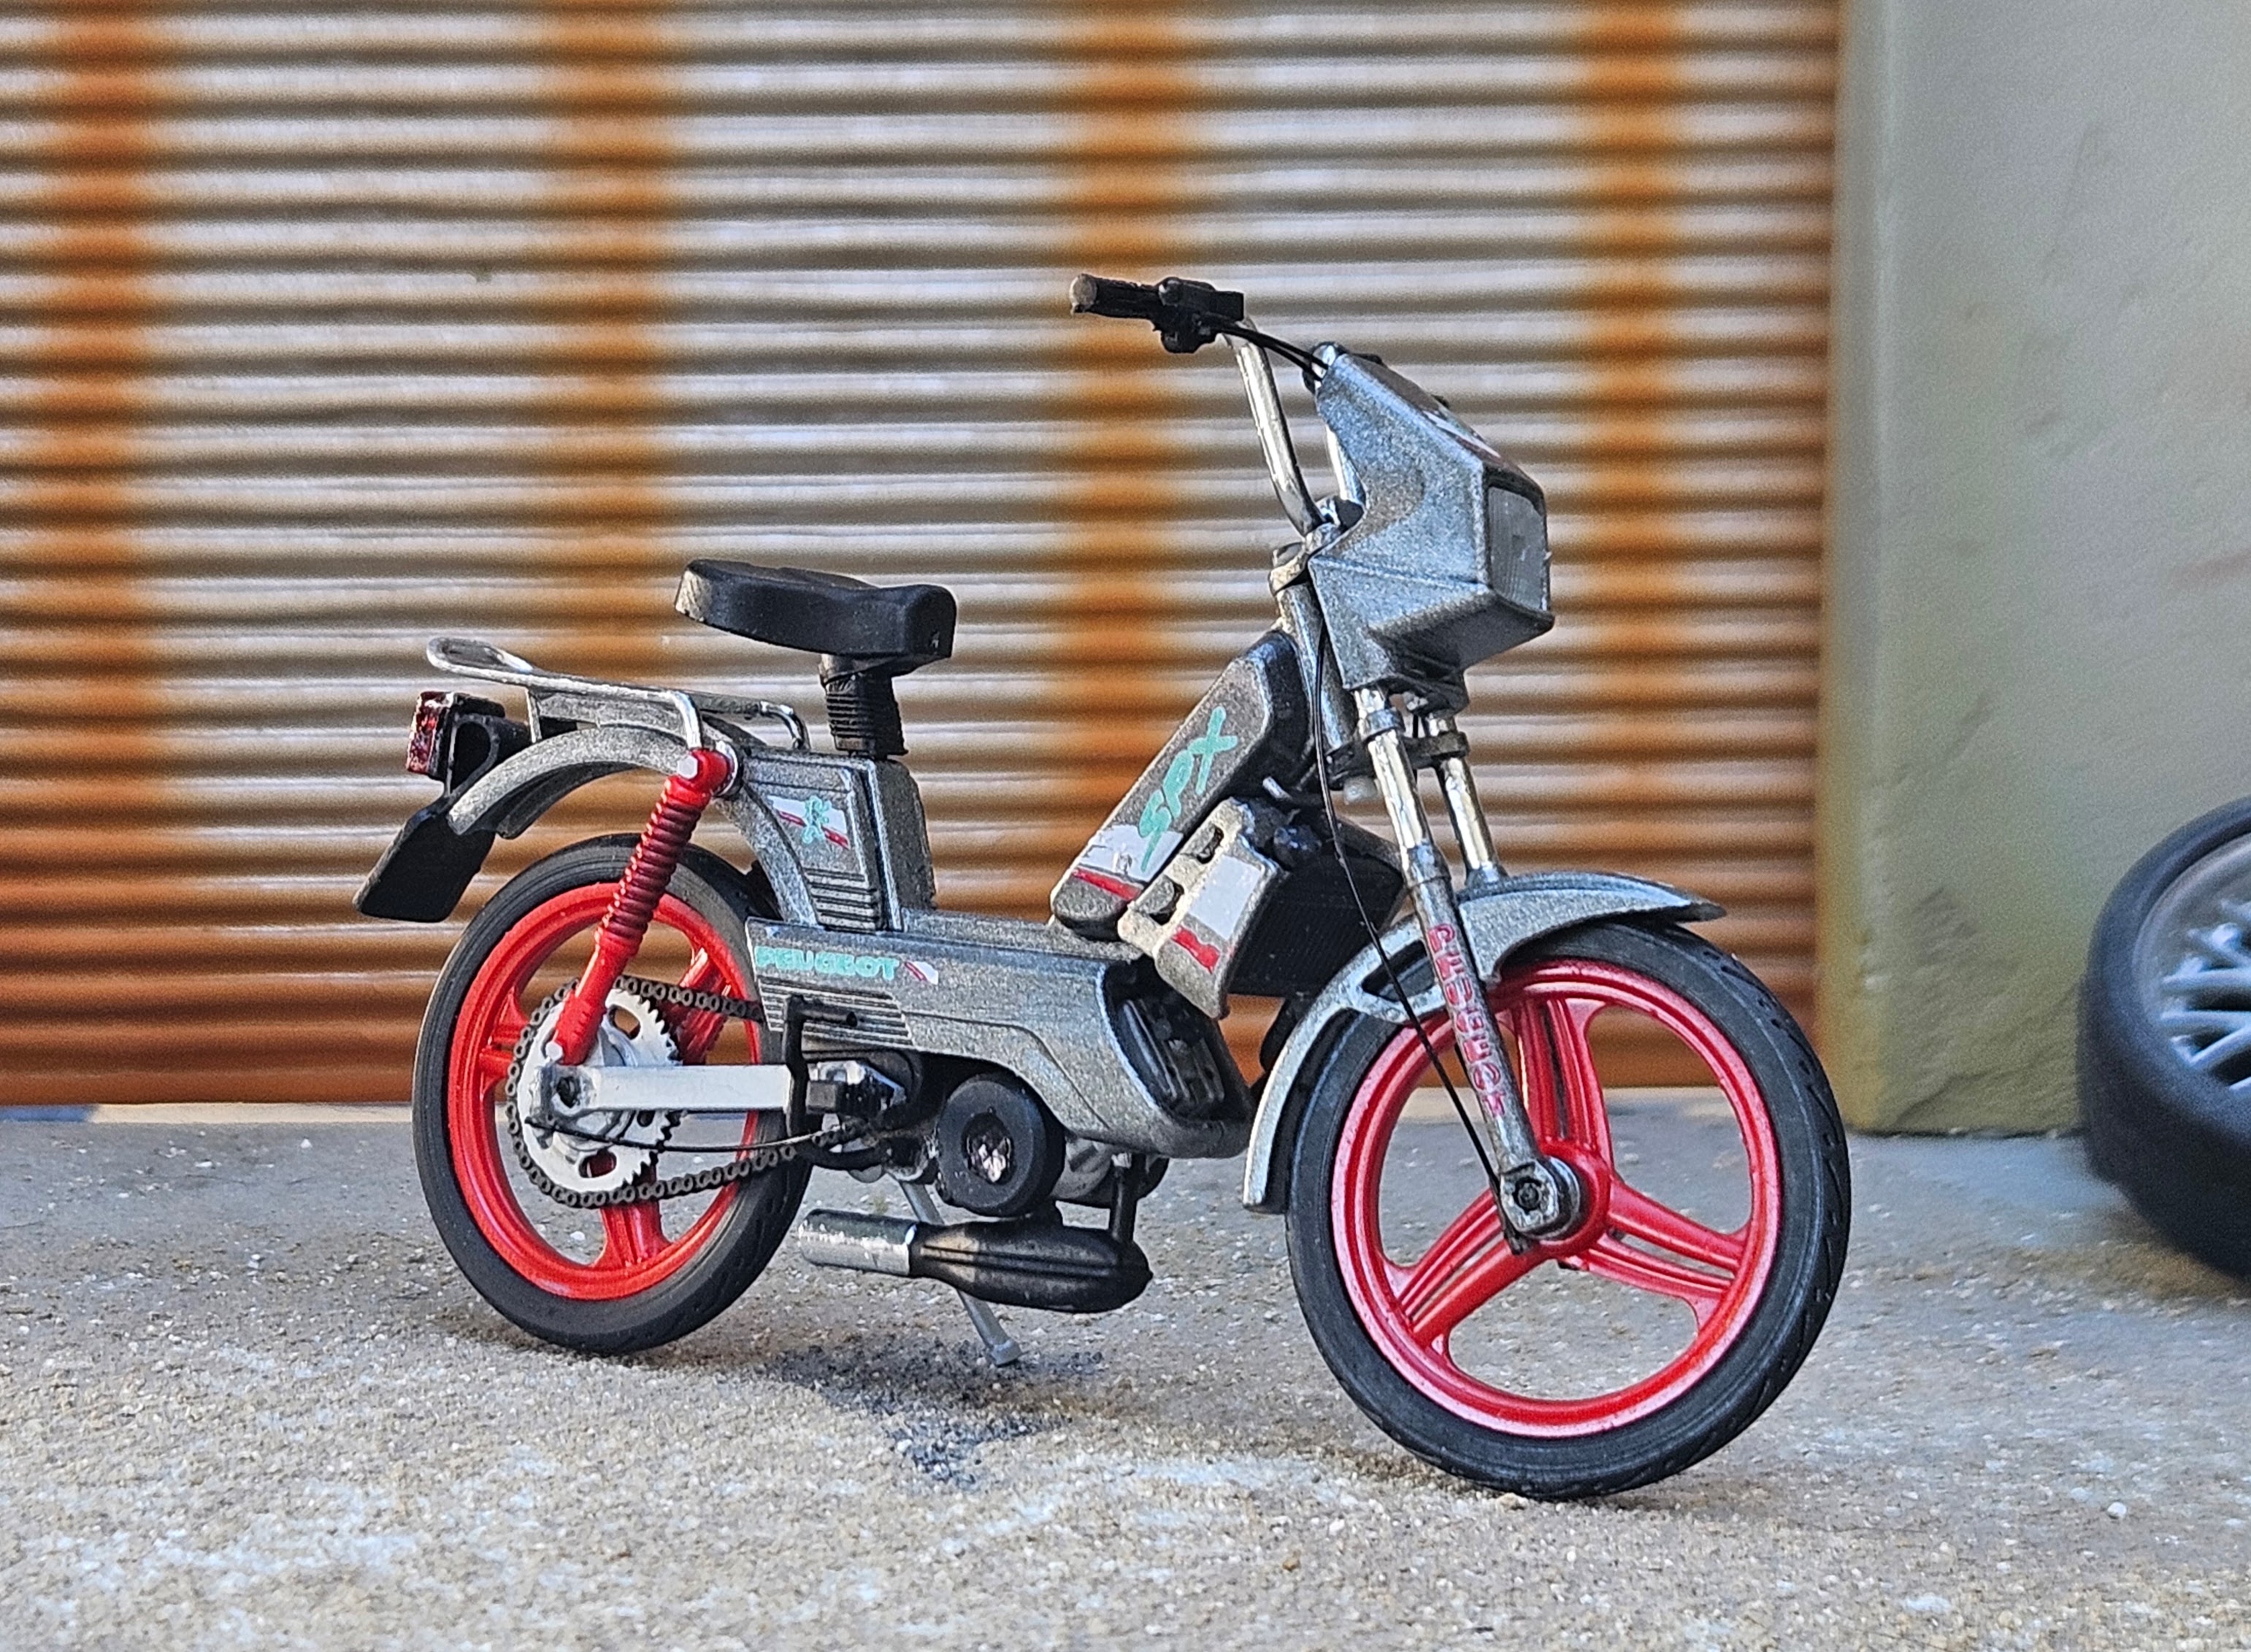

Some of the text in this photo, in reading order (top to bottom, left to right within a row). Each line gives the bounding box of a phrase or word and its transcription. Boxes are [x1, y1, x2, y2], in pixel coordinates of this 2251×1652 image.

[1138, 705, 1238, 872] SPX
[753, 945, 900, 980] PEUGEOT
[1428, 923, 1506, 1118] PEUGEOT
